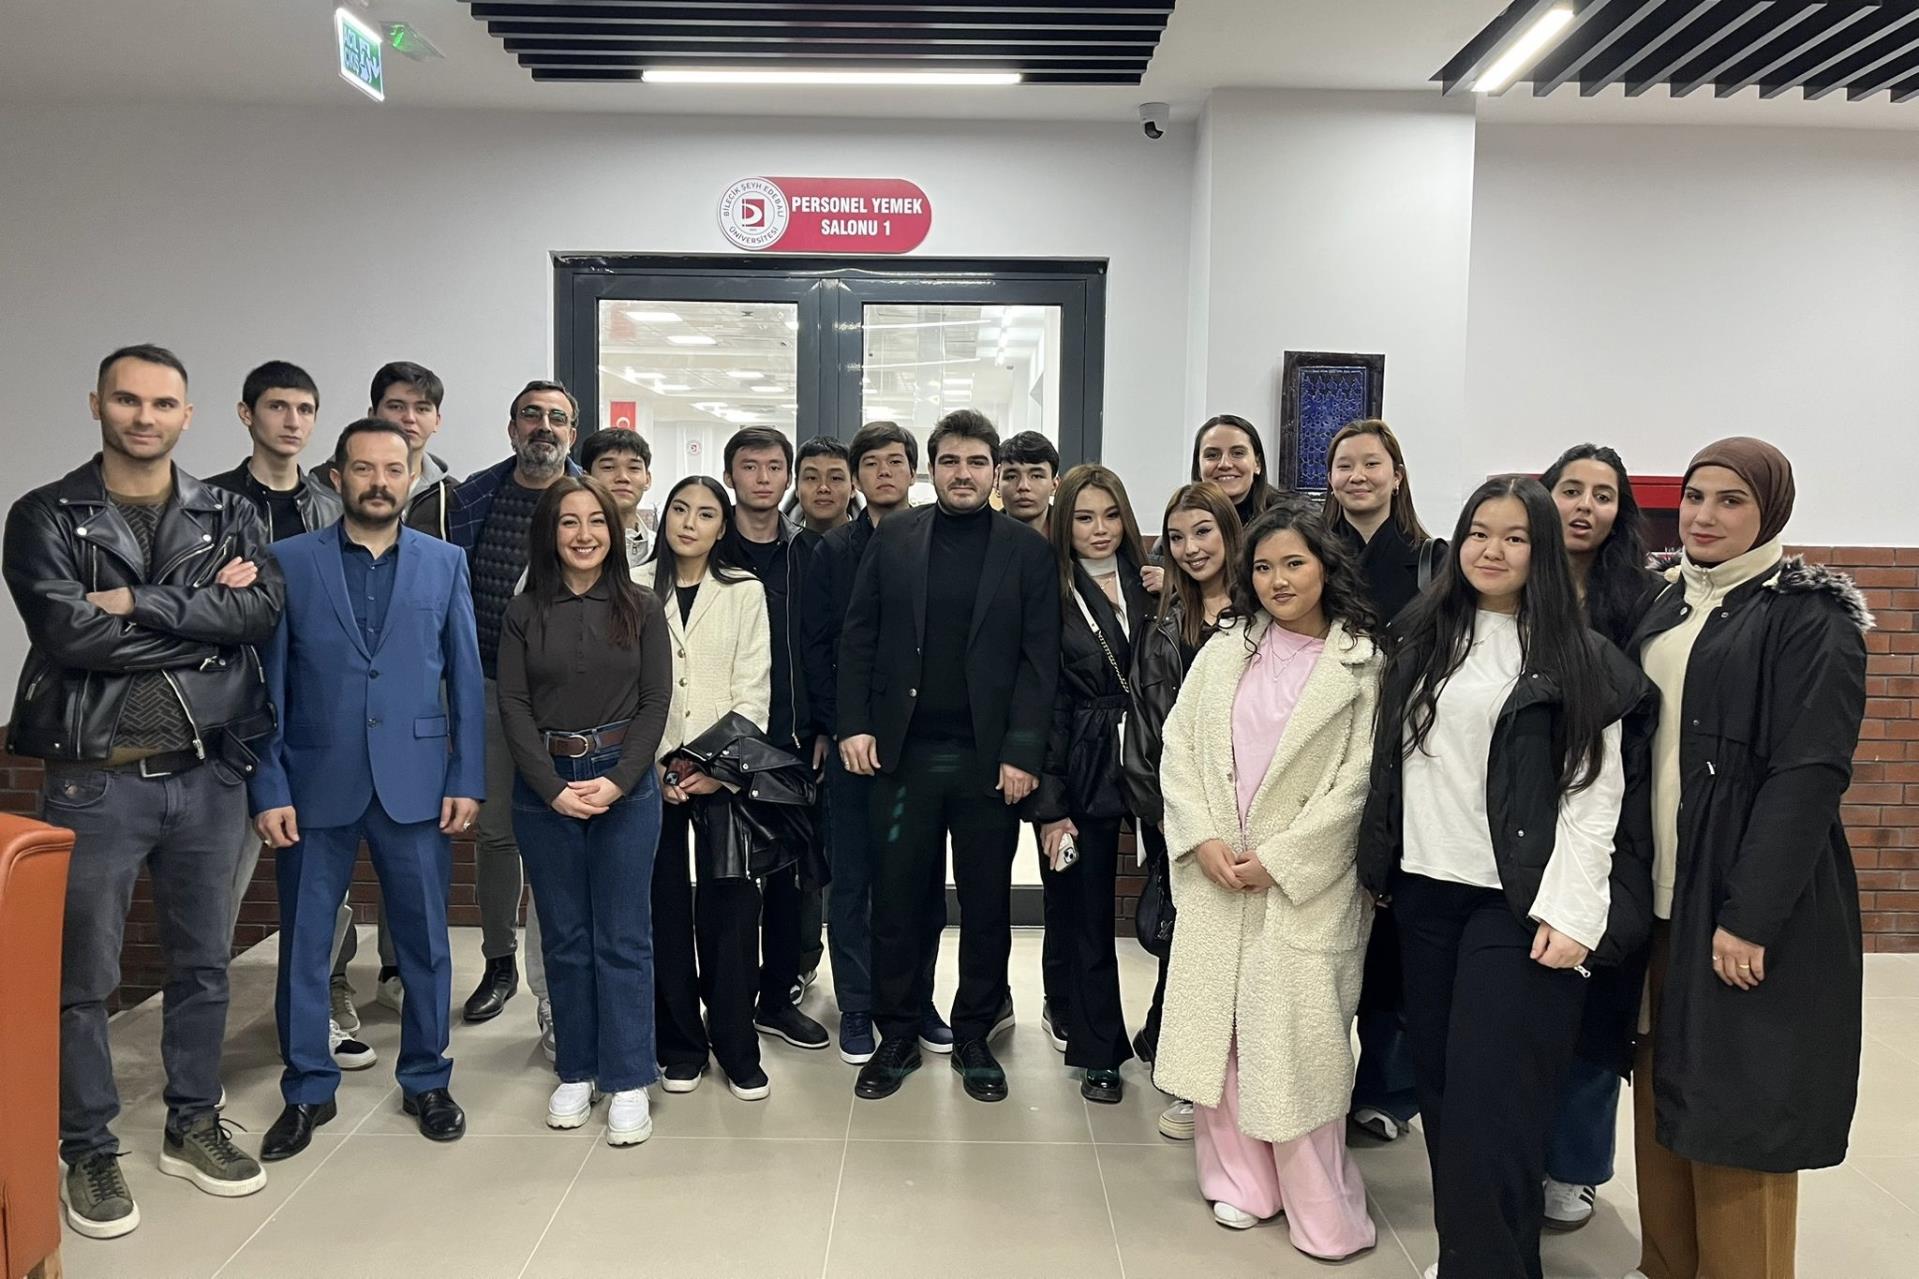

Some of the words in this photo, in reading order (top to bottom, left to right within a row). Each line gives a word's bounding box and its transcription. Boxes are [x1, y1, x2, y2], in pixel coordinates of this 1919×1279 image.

[791, 196, 868, 213] PERSONEL
[871, 197, 923, 214] YEMEK
[821, 218, 878, 235] SALONU
[883, 219, 891, 235] 1
